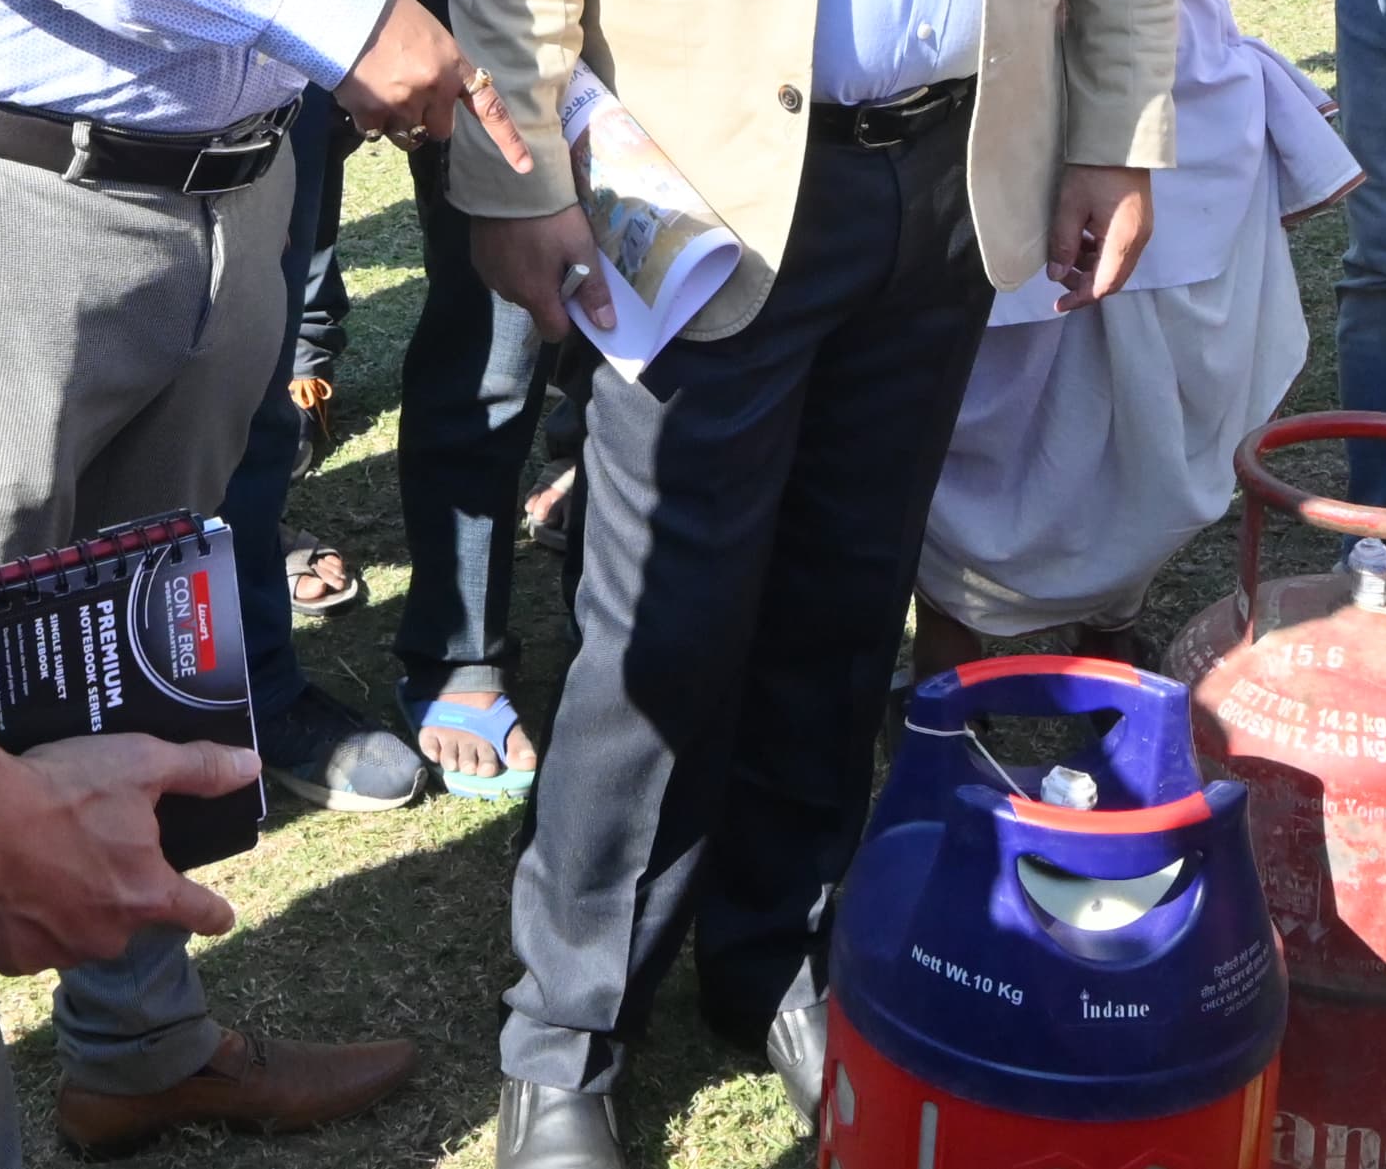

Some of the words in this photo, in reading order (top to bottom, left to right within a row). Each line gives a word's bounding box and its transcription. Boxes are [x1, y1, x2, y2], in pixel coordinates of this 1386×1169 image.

[49, 613, 62, 653] SINGLE
[79, 604, 98, 684] NOTEBOOK
[197, 603, 210, 641] Luxor
[34, 617, 49, 680] NOTEBOOK
[97, 599, 123, 708] PREMIUM
[1282, 643, 1345, 669] 15.6
[53, 654, 67, 700] SUBJECT
[87, 686, 102, 732] SERIES
[1217, 698, 1274, 739] GROSS
[1312, 730, 1359, 757] 29.8
[1230, 678, 1279, 711] NETT
[1277, 697, 1310, 724] WT.
[1318, 708, 1358, 732] 14.2
[911, 944, 942, 974] Nett
[998, 981, 1024, 1006] Kg
[1200, 996, 1225, 1012] CHECK
[1226, 988, 1241, 1002] SEAL
[1241, 977, 1254, 992] AND
[1080, 992, 1150, 1019] Indane
